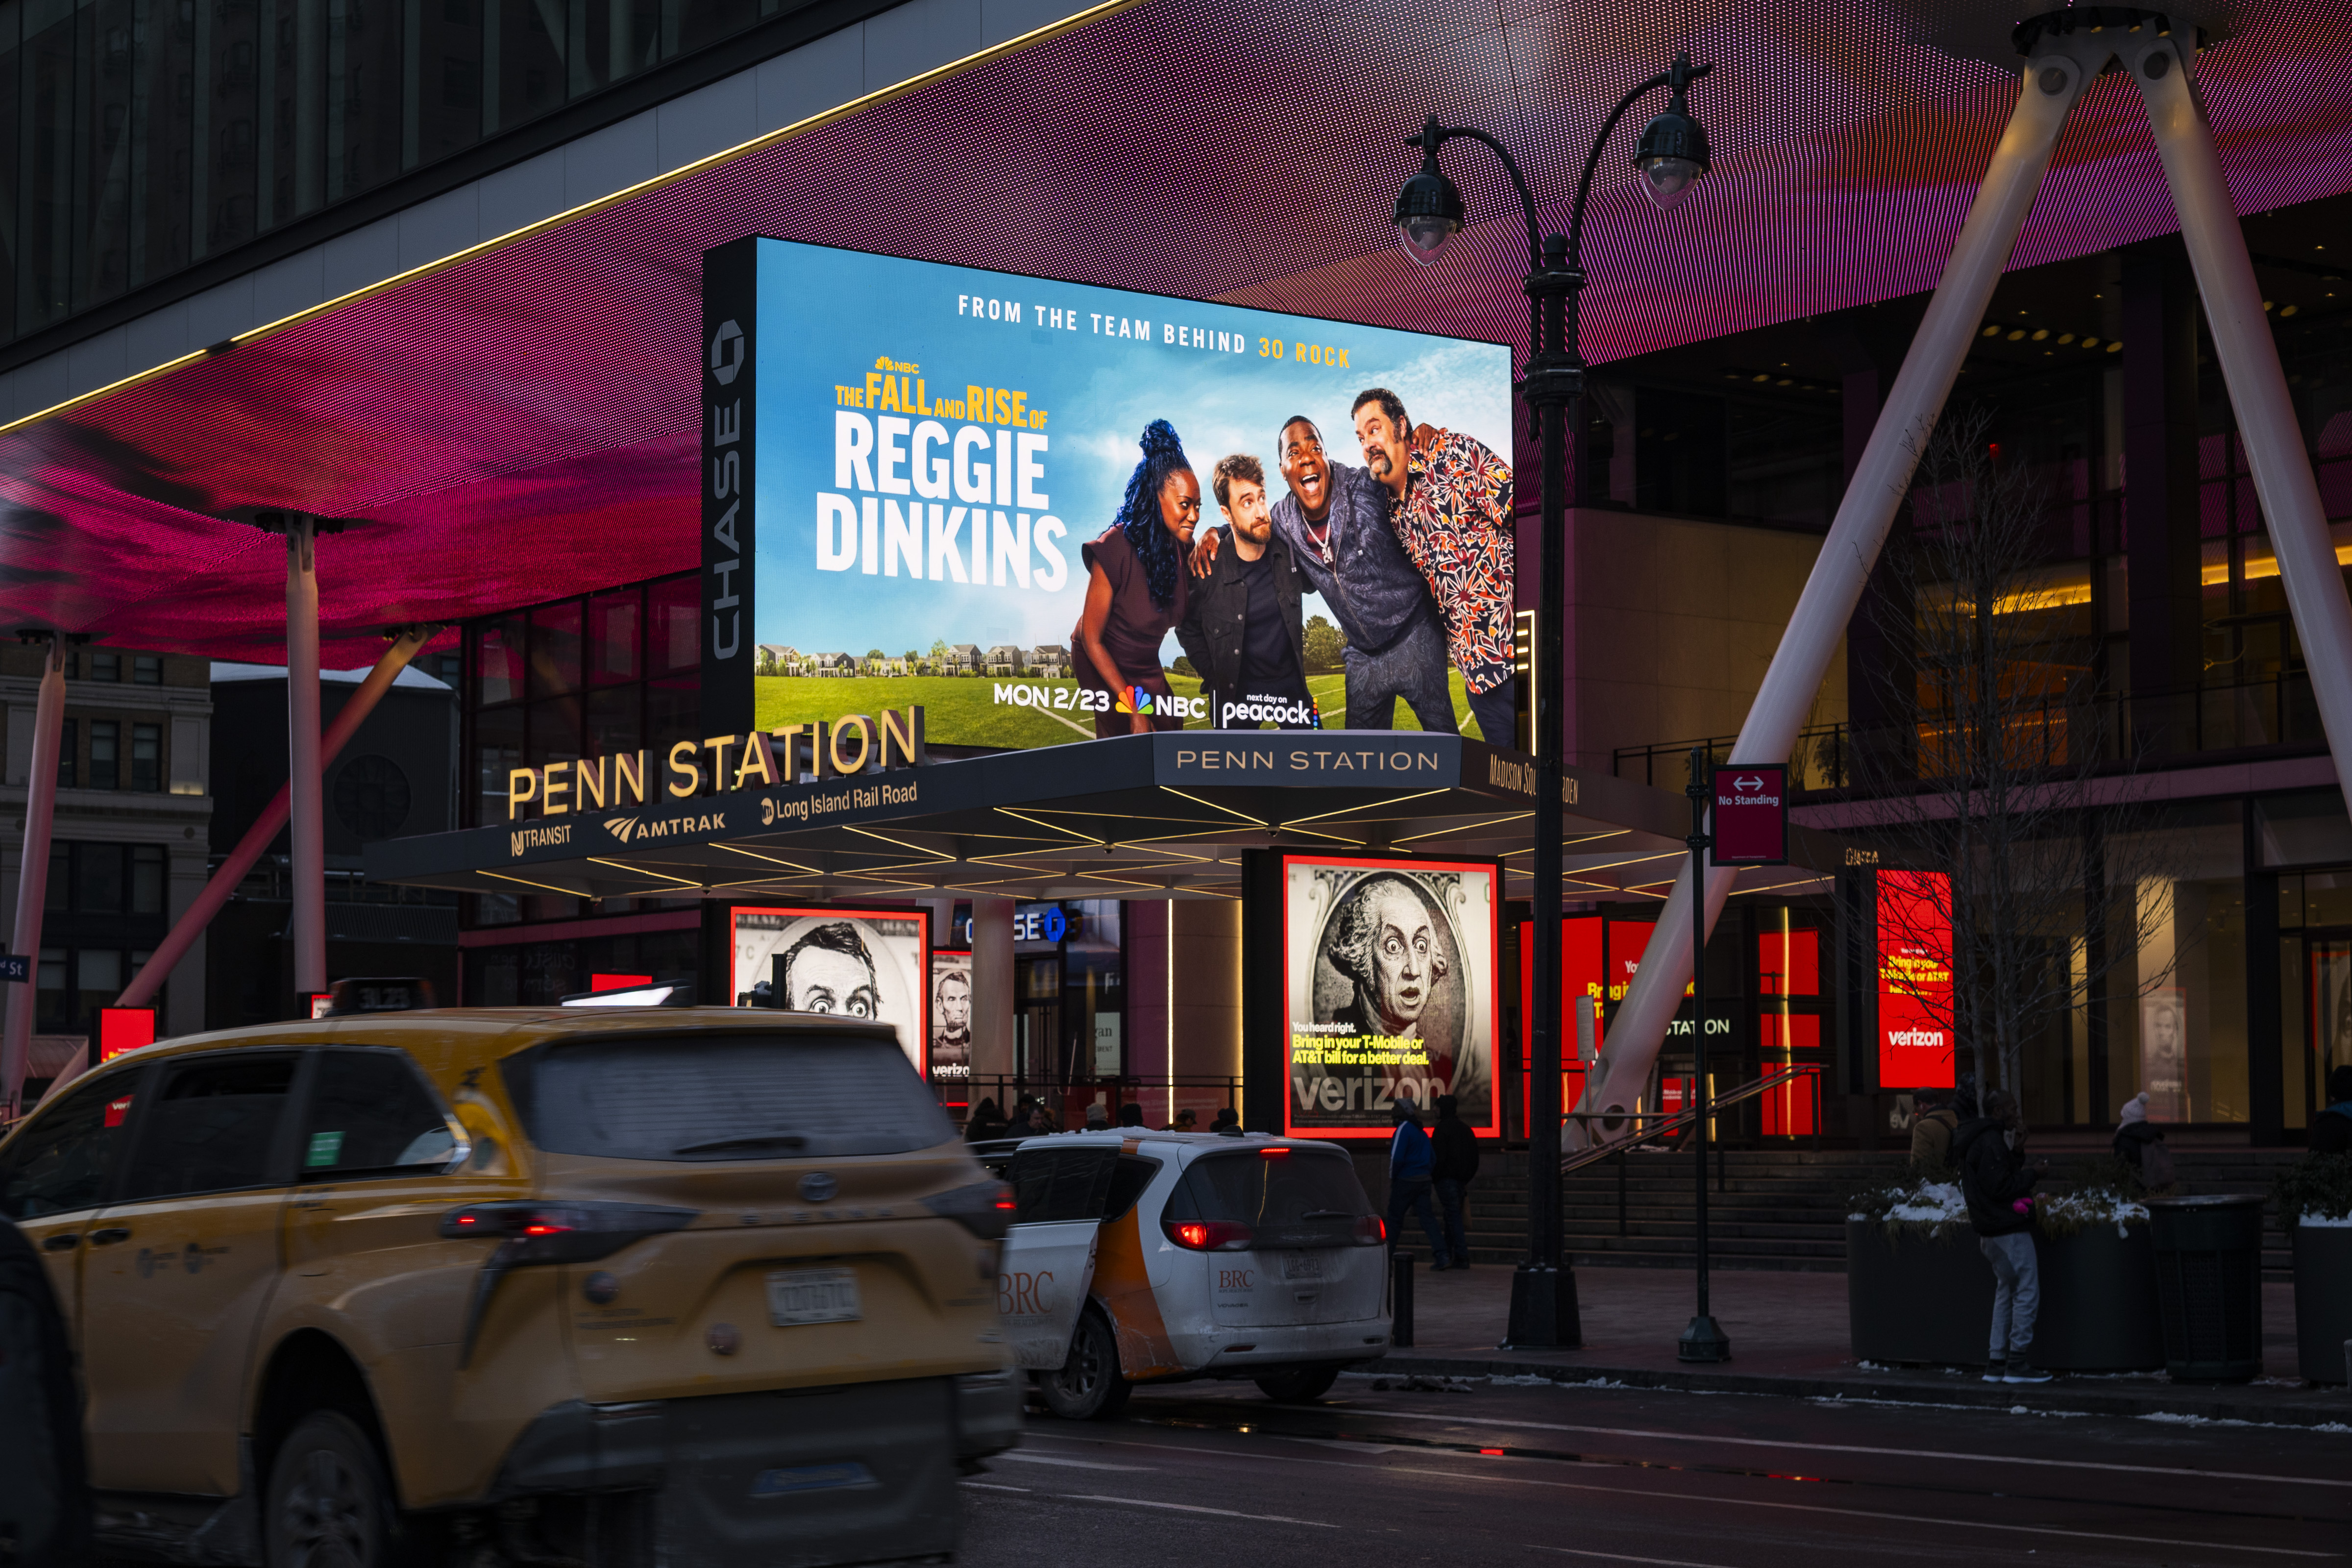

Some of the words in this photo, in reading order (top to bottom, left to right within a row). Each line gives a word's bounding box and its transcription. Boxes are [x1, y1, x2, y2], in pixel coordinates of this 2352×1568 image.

[958, 294, 1021, 323] FROM
[1034, 305, 1077, 331] THE
[1090, 313, 1151, 342] TEAM
[1163, 325, 1245, 354] BEHIND
[1259, 337, 1283, 359] 30
[1296, 343, 1350, 368] ROCK
[894, 361, 919, 374] NBC
[835, 385, 864, 408] THE
[866, 372, 932, 416] FALL
[934, 398, 965, 420] AND
[966, 385, 1028, 427] RISE
[1029, 410, 1048, 430] OF
[835, 410, 1049, 510] REGGIE
[713, 397, 740, 660] CHASE
[816, 492, 1068, 592] DINKINS
[993, 683, 1049, 707] MON
[1054, 687, 1109, 711] 2/23
[1156, 695, 1206, 719] NBC
[1247, 694, 1263, 702] next
[1264, 695, 1277, 704] day
[1223, 700, 1310, 729] peacock
[510, 749, 645, 820] PENN
[669, 706, 916, 798] STATION
[1177, 751, 1273, 770] PENN
[1290, 751, 1438, 771] STATION
[777, 800, 808, 821] Long
[811, 795, 850, 814] Island
[854, 787, 879, 809] Rail
[882, 782, 917, 804] Road
[1718, 796, 1732, 805] No
[1735, 794, 1779, 807] Standing
[524, 825, 571, 848] TRANSIT
[637, 812, 726, 839] AMTRAK
[9, 961, 23, 976] St
[1292, 1022, 1309, 1032] You
[1309, 1022, 1334, 1032] heard
[1334, 1023, 1356, 1034] right.
[1888, 1028, 1943, 1046] verizon
[1292, 1034, 1324, 1050] Bring
[1324, 1034, 1335, 1048] in
[1336, 1037, 1362, 1050] your
[1362, 1035, 1410, 1050] T-Mobile
[1411, 1039, 1423, 1049] or
[1292, 1050, 1324, 1064] AT&T
[1324, 1050, 1341, 1064] bill
[1342, 1050, 1359, 1064] for
[1359, 1053, 1367, 1064] a
[1367, 1051, 1402, 1065] better
[1402, 1051, 1429, 1065] deal.
[1293, 1067, 1446, 1111] verizon
[1219, 1270, 1255, 1288] BRC
[999, 1271, 1054, 1315] BRC
